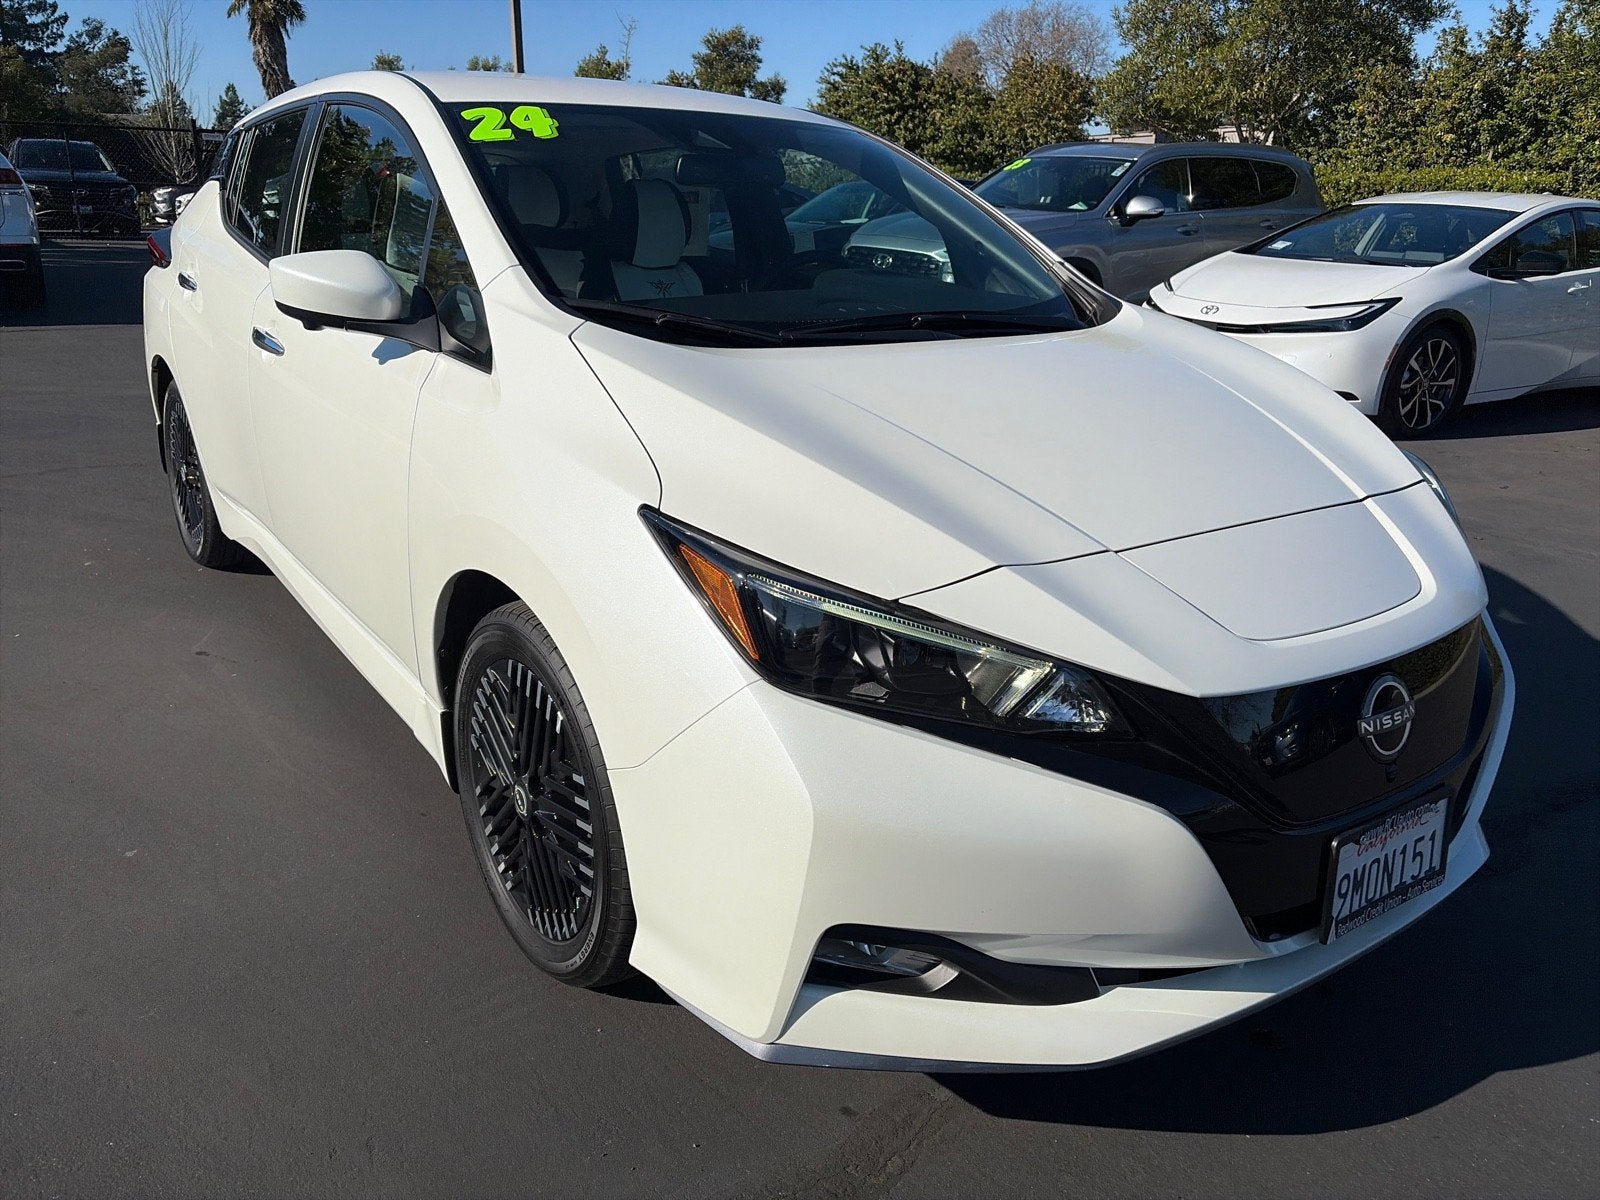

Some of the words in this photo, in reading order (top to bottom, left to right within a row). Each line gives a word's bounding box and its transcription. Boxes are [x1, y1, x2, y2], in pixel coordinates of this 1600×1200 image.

[461, 106, 559, 141] 24
[1361, 705, 1415, 734] NISSAN
[1336, 829, 1437, 921] 9MON151
[1338, 916, 1367, 936] Redwood
[1366, 902, 1383, 920] Credit
[1384, 895, 1402, 911] Union
[1407, 886, 1421, 900] Auto
[578, 931, 595, 963] ENERGY
